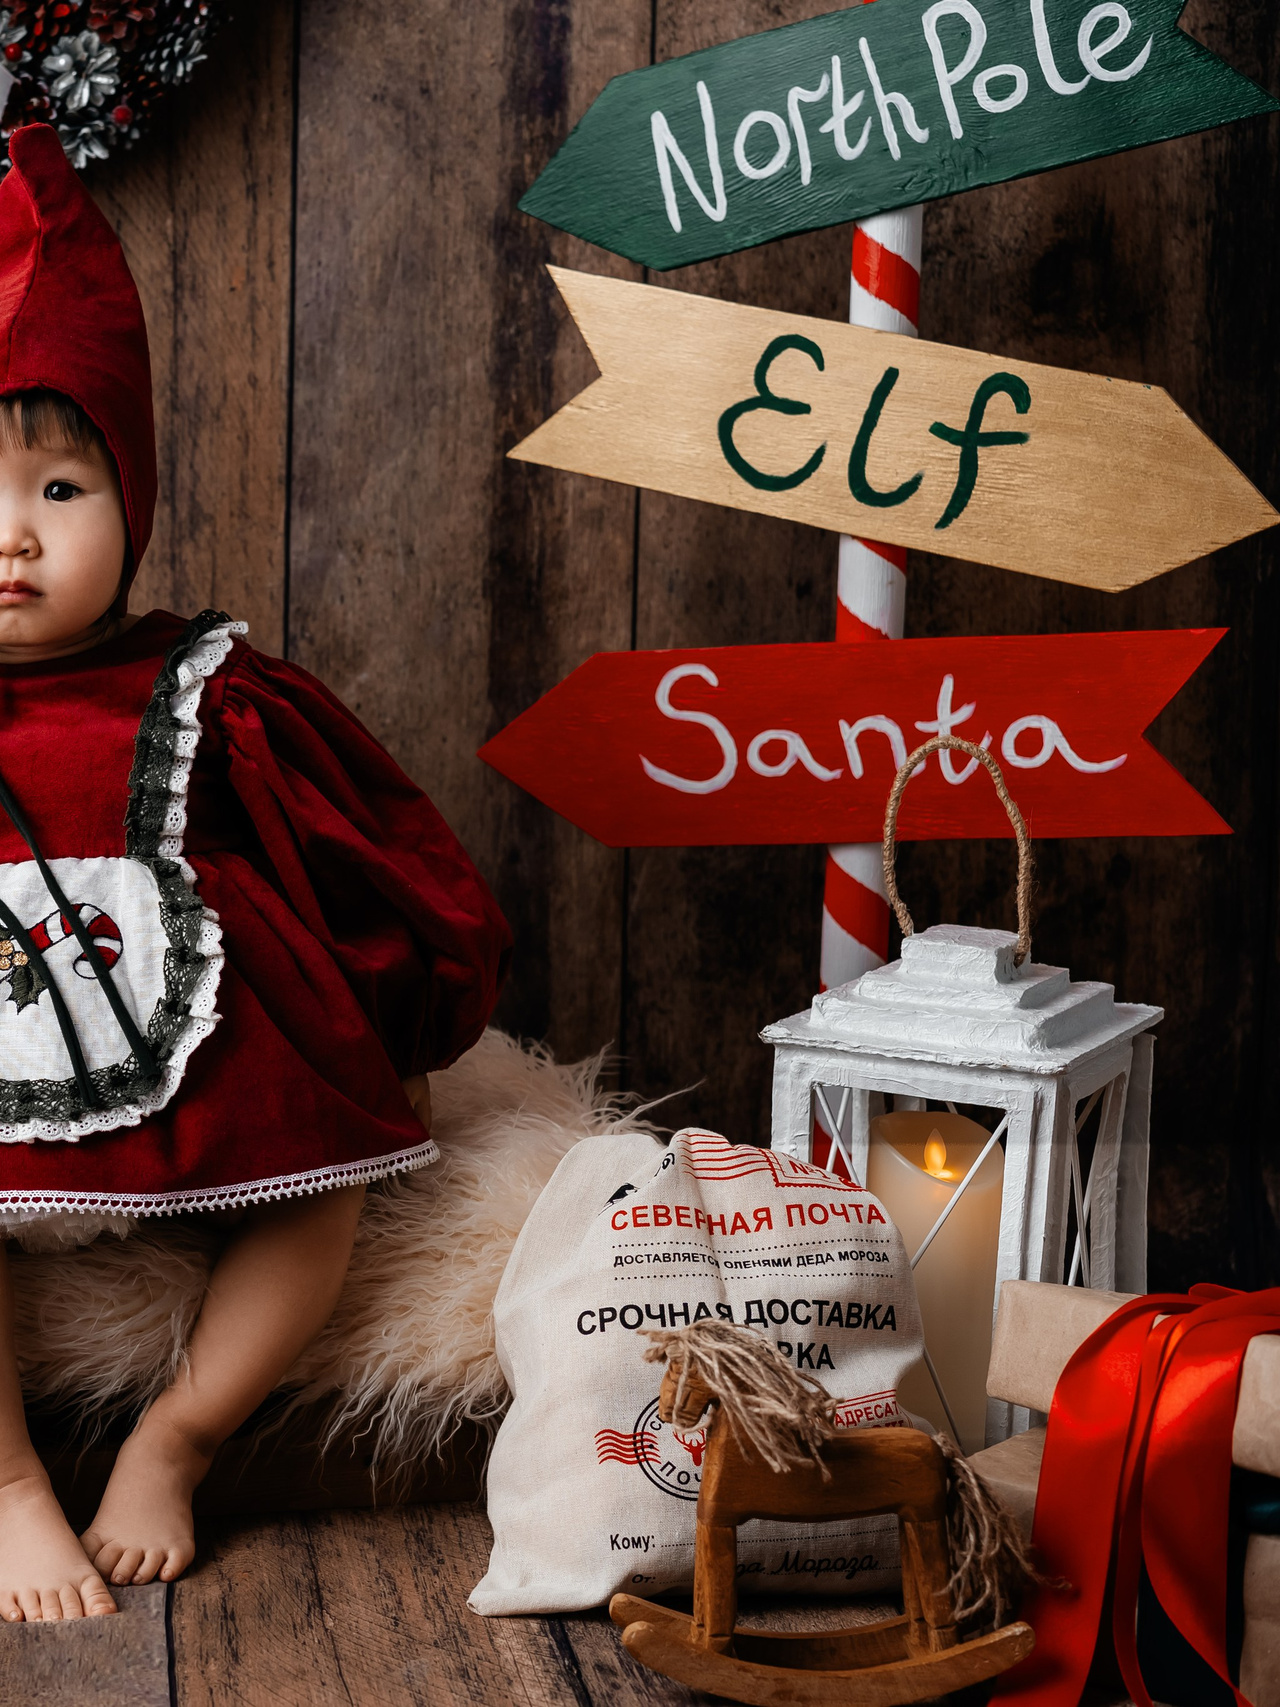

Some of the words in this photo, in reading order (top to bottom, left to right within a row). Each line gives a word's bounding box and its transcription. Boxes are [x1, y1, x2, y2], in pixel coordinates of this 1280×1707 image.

[651, 37, 929, 233] North
[921, 0, 1154, 140] Pole
[639, 662, 1128, 795] Santa
[610, 1204, 773, 1236] СЕВЕРНАЯ
[785, 1203, 887, 1228] ПОЧТА
[724, 1256, 793, 1270] ОЛЕНЯМИ
[796, 1252, 834, 1268] ДЕДА
[838, 1250, 890, 1263] МОРОЗА
[576, 1302, 735, 1335] СРОЧНАЯ
[743, 1299, 897, 1331] ДОСТАВКА
[610, 1533, 656, 1553] Кому:
